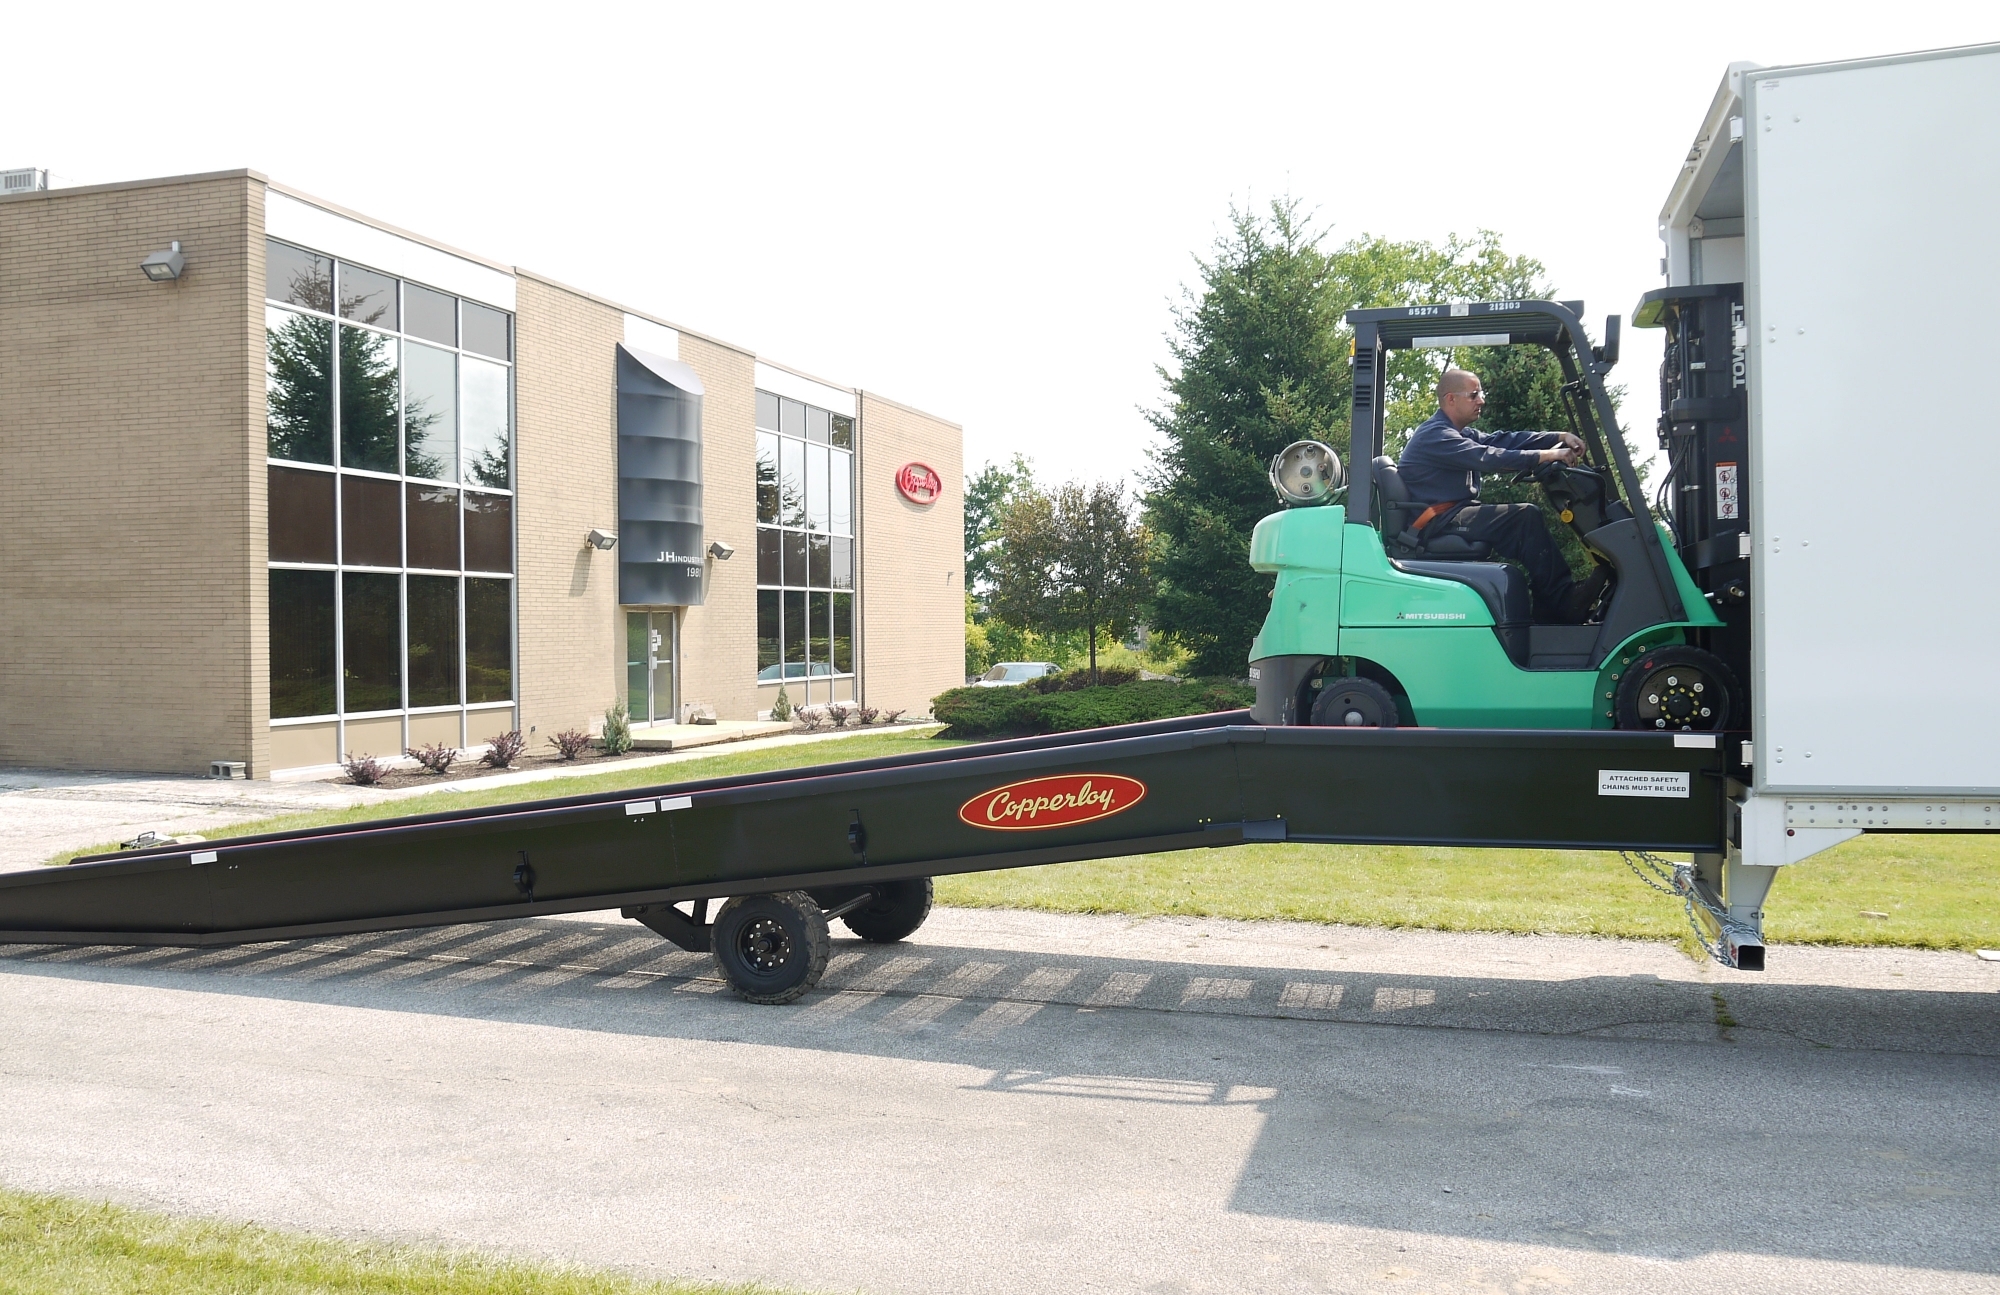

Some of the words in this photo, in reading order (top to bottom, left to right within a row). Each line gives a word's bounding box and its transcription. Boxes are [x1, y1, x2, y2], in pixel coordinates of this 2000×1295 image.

[1408, 307, 1438, 316] 85274
[1489, 301, 1520, 311] 212103
[986, 780, 1116, 822] Copperloy
